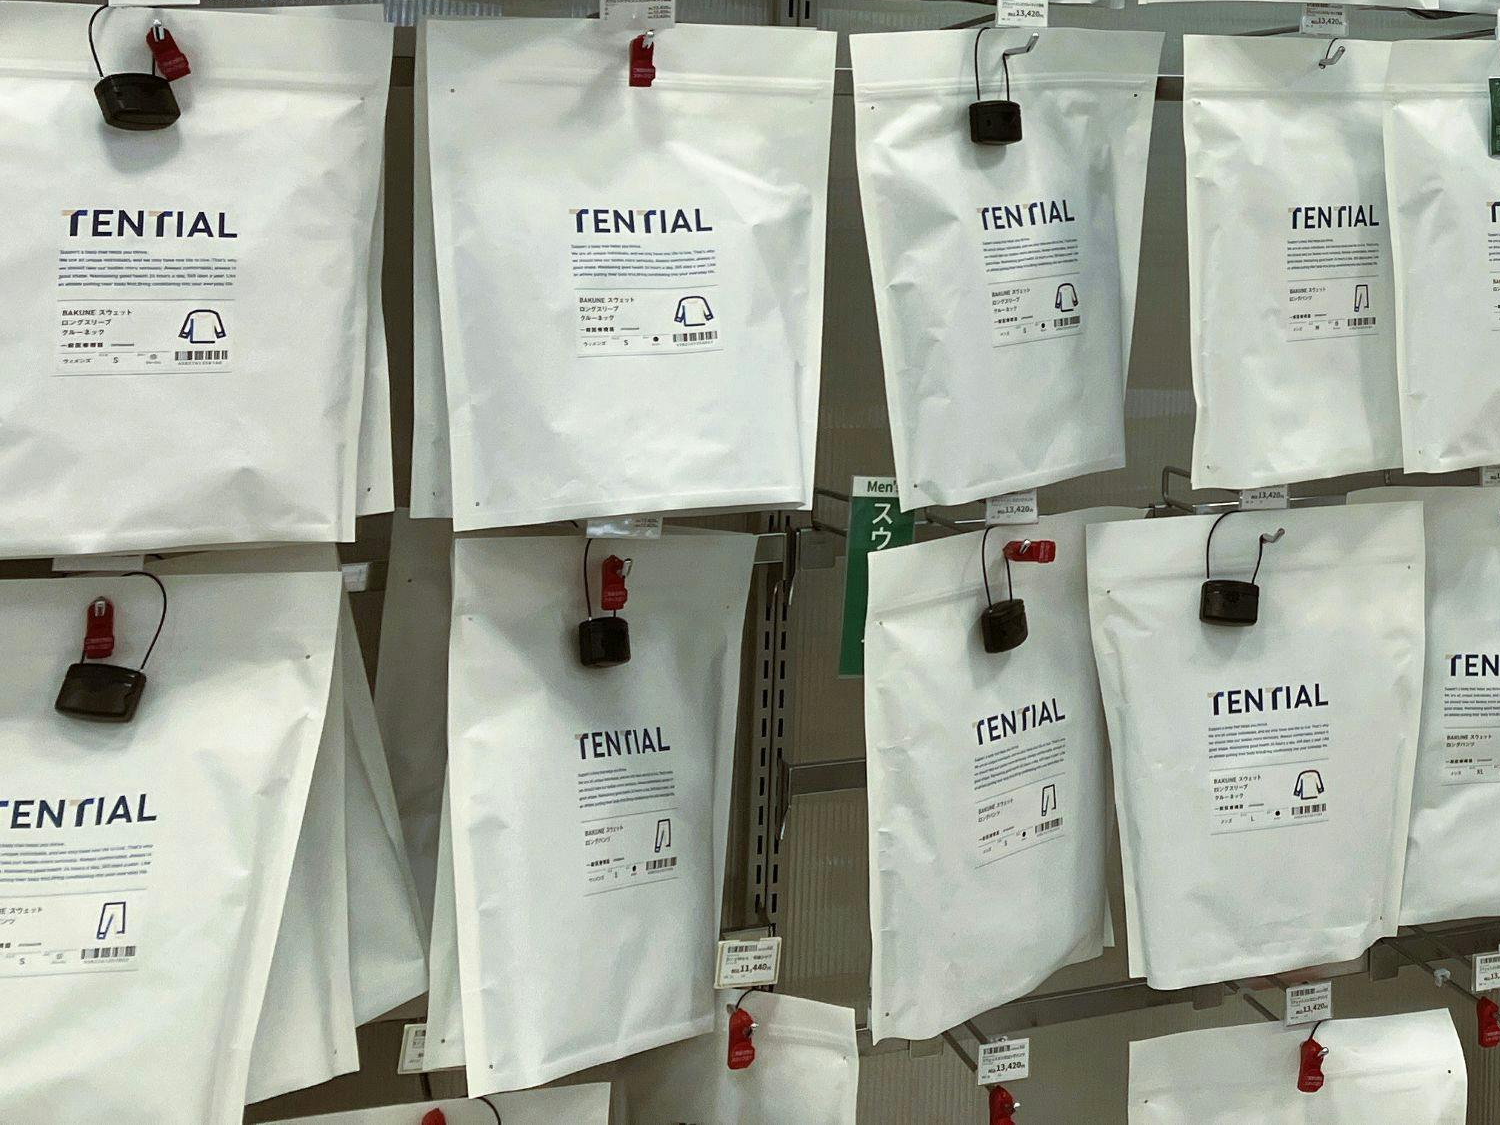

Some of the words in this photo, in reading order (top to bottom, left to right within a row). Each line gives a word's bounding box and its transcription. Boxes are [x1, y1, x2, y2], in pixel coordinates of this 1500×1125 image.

[61, 209, 238, 238] TENTIAL
[569, 208, 713, 233] TENTIAL
[977, 199, 1075, 230] TENTIAL
[1288, 204, 1379, 230] TENTIAL
[1207, 683, 1329, 716] TENTIAL
[972, 698, 1066, 745] TENTIAL
[575, 727, 670, 760] TENTIAL
